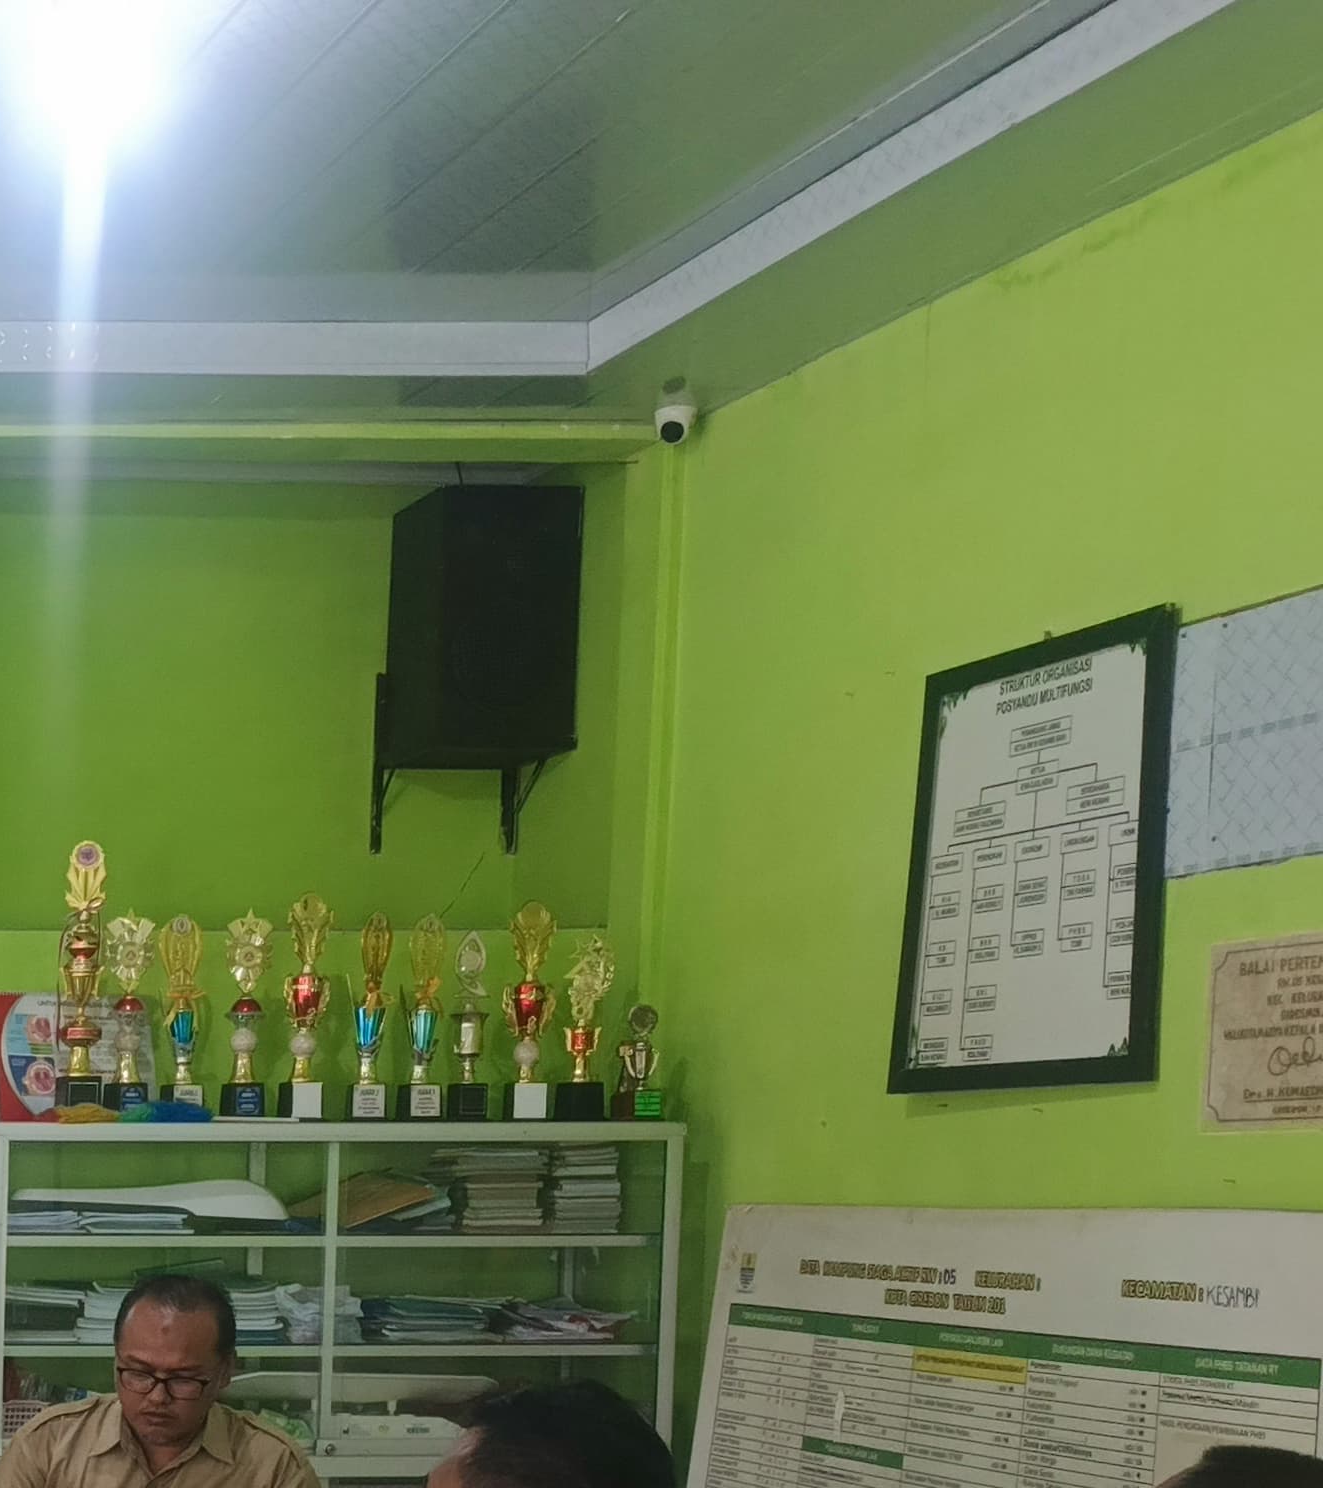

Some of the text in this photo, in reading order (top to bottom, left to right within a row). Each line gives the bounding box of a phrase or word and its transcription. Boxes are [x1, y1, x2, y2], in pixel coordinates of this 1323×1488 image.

[1000, 656, 1093, 695] STRUKTUR ORGANISASI
[995, 678, 1093, 716] POSYANDU MULTIFUNGSI
[1239, 959, 1275, 976] BALAI
[974, 1270, 1036, 1291] KELURAHAN
[1121, 1279, 1197, 1302] KECAMATAN
[1206, 1285, 1260, 1308] KESAMBI
